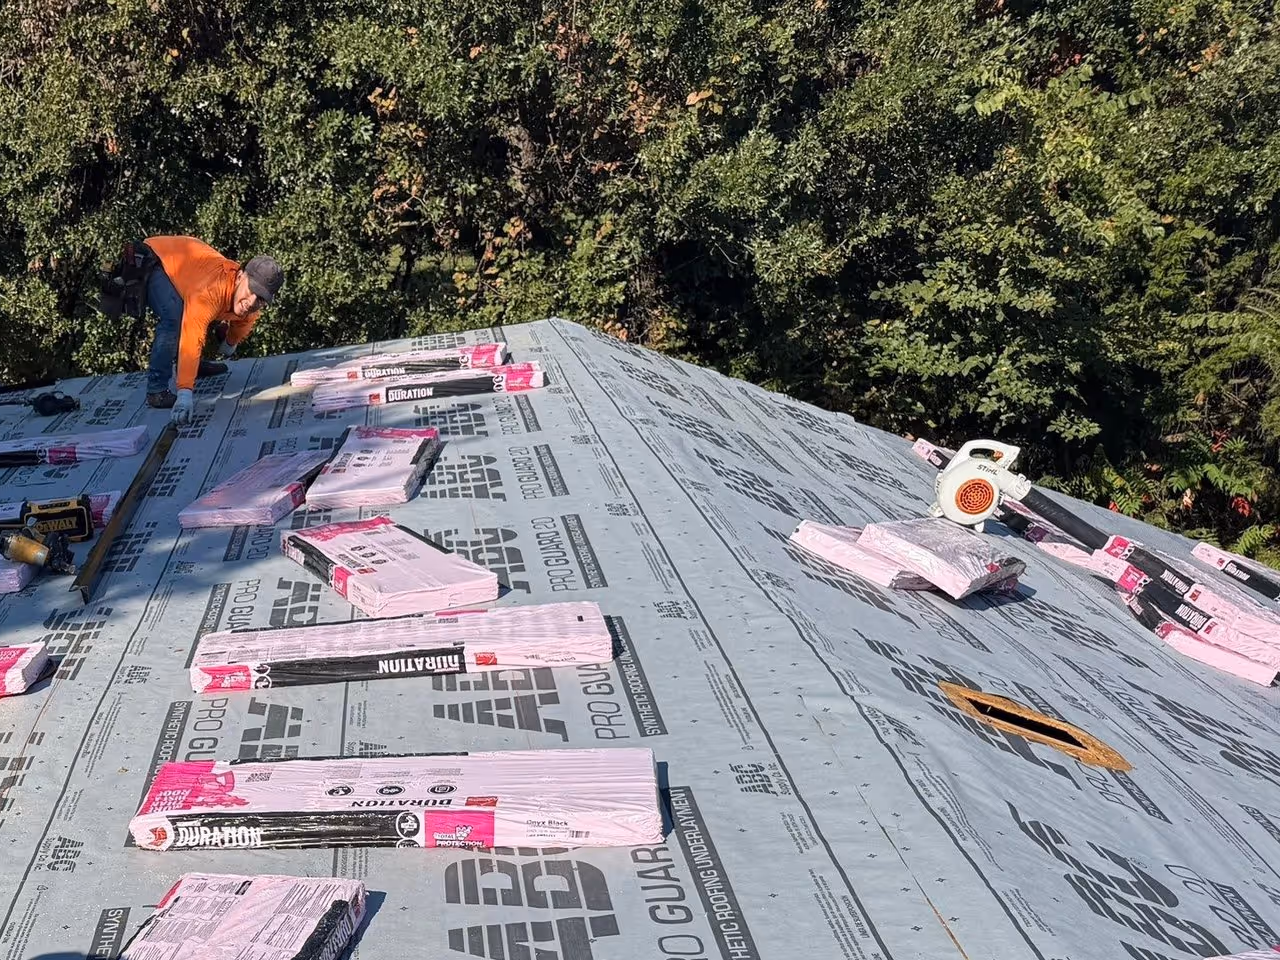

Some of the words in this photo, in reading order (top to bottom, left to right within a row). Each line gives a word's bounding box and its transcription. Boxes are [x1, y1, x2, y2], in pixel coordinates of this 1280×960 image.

[388, 387, 435, 402] DURATION
[976, 464, 999, 476] STIHL
[531, 516, 555, 530] 20
[536, 532, 571, 568] GUARD
[547, 568, 580, 592] PRO
[225, 606, 254, 630] GUA
[1175, 603, 1208, 630] DURATION
[377, 653, 461, 674] DURATION
[576, 663, 615, 696] GUA
[194, 699, 229, 731] PRO
[586, 700, 631, 740] PRO
[176, 826, 263, 847] DURATION
[670, 788, 715, 869] UNDERLAYMENT
[631, 846, 694, 925] GUAR
[700, 869, 738, 921] ROOFING
